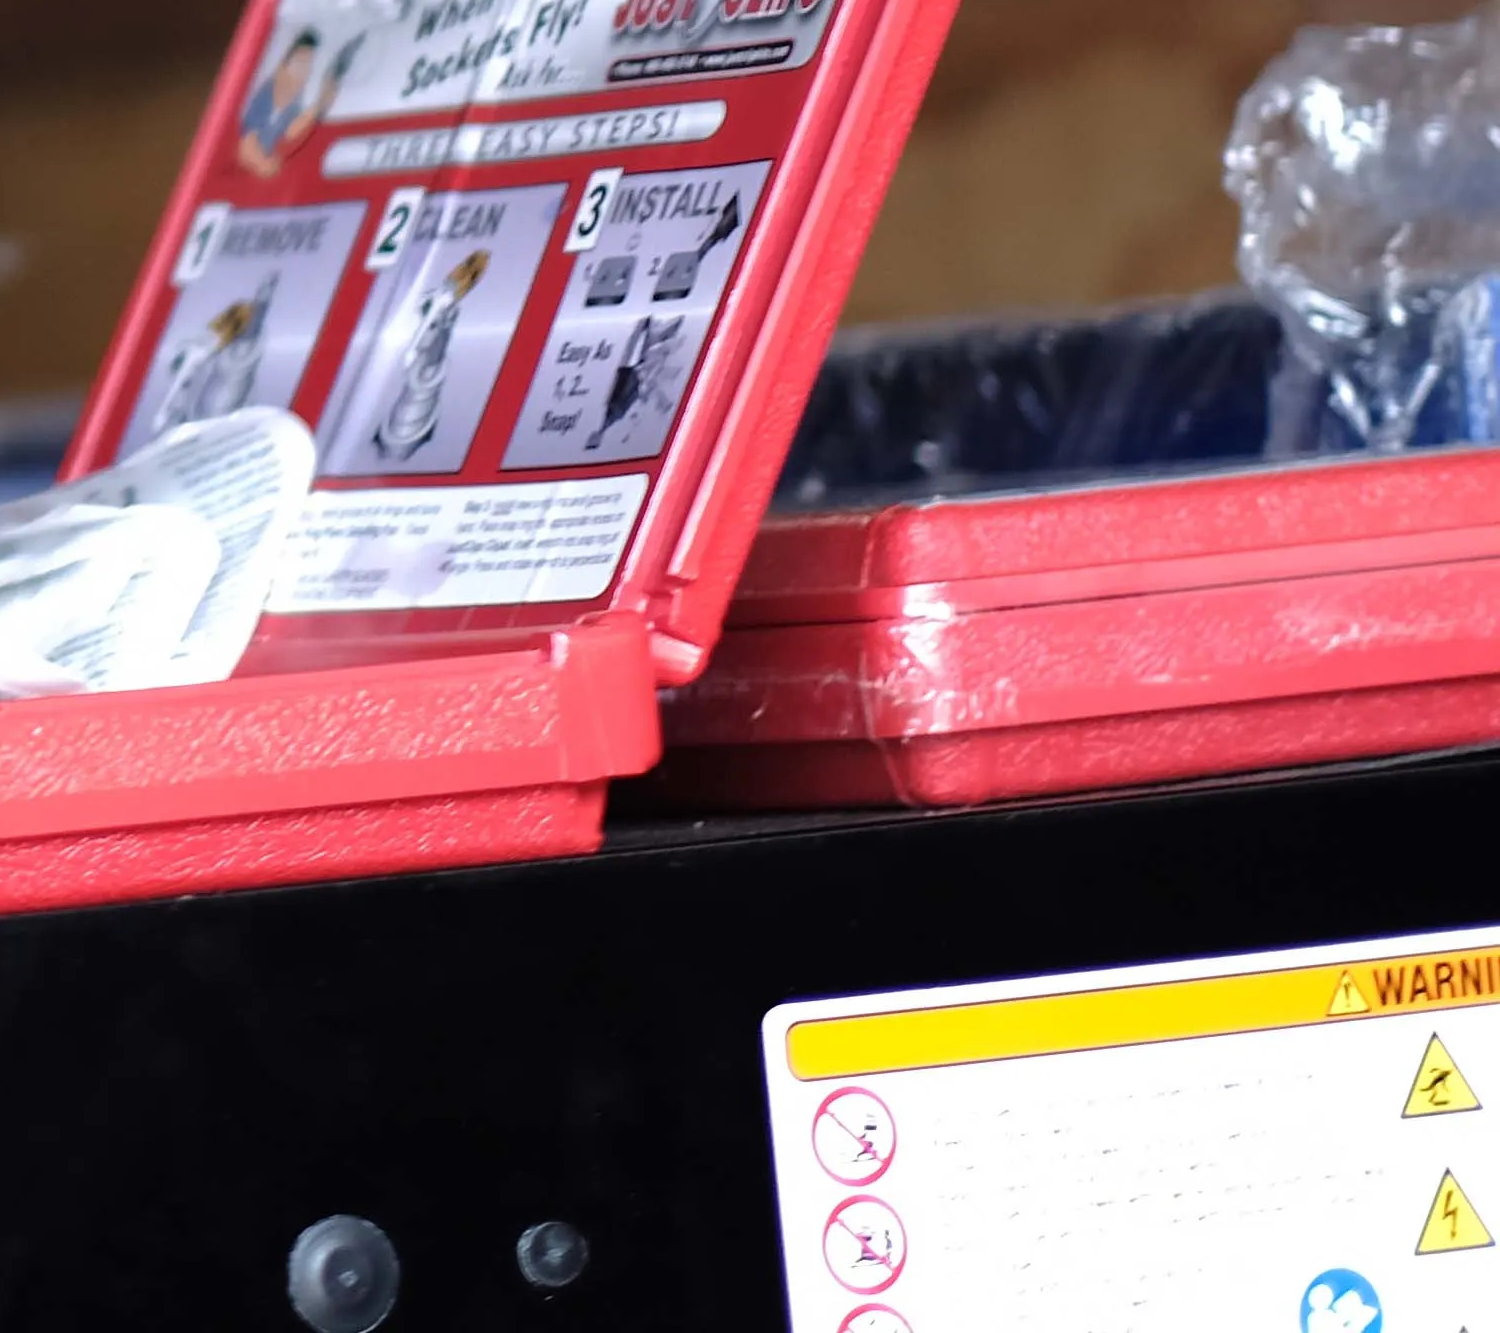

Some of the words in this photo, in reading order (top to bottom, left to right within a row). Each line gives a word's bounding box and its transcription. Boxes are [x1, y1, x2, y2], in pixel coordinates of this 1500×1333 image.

[363, 125, 459, 171] THREE
[476, 121, 562, 160] EASY
[567, 108, 682, 151] STEPS!
[377, 204, 411, 254] 2
[412, 203, 509, 242] CLEAN
[577, 184, 608, 237] 3
[610, 181, 723, 224] INSTALL
[192, 221, 217, 269] 1
[219, 216, 331, 257] REMOVE
[1372, 955, 1500, 1007] WARNI
